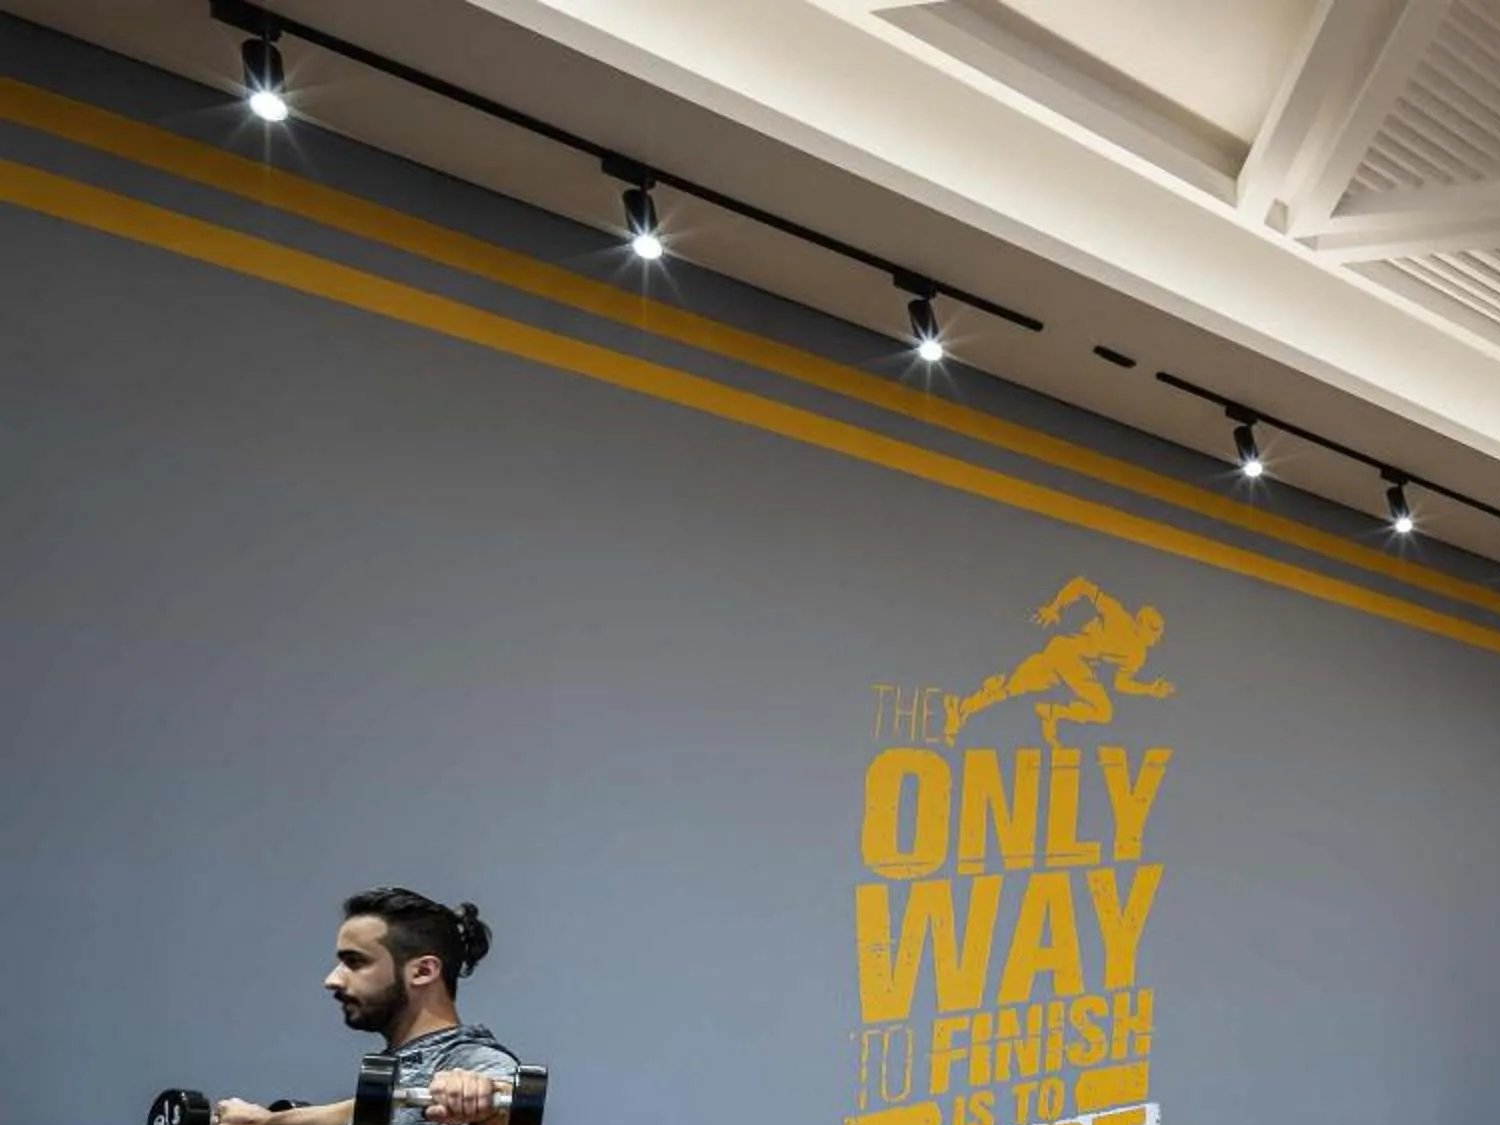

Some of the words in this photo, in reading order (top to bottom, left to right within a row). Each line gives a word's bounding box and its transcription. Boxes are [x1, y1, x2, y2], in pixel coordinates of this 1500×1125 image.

[869, 683, 942, 744] THE
[859, 746, 1175, 880] ONLY
[853, 863, 1166, 1024] WAY
[852, 1022, 914, 1111] TO
[929, 988, 1154, 1095] FINISH
